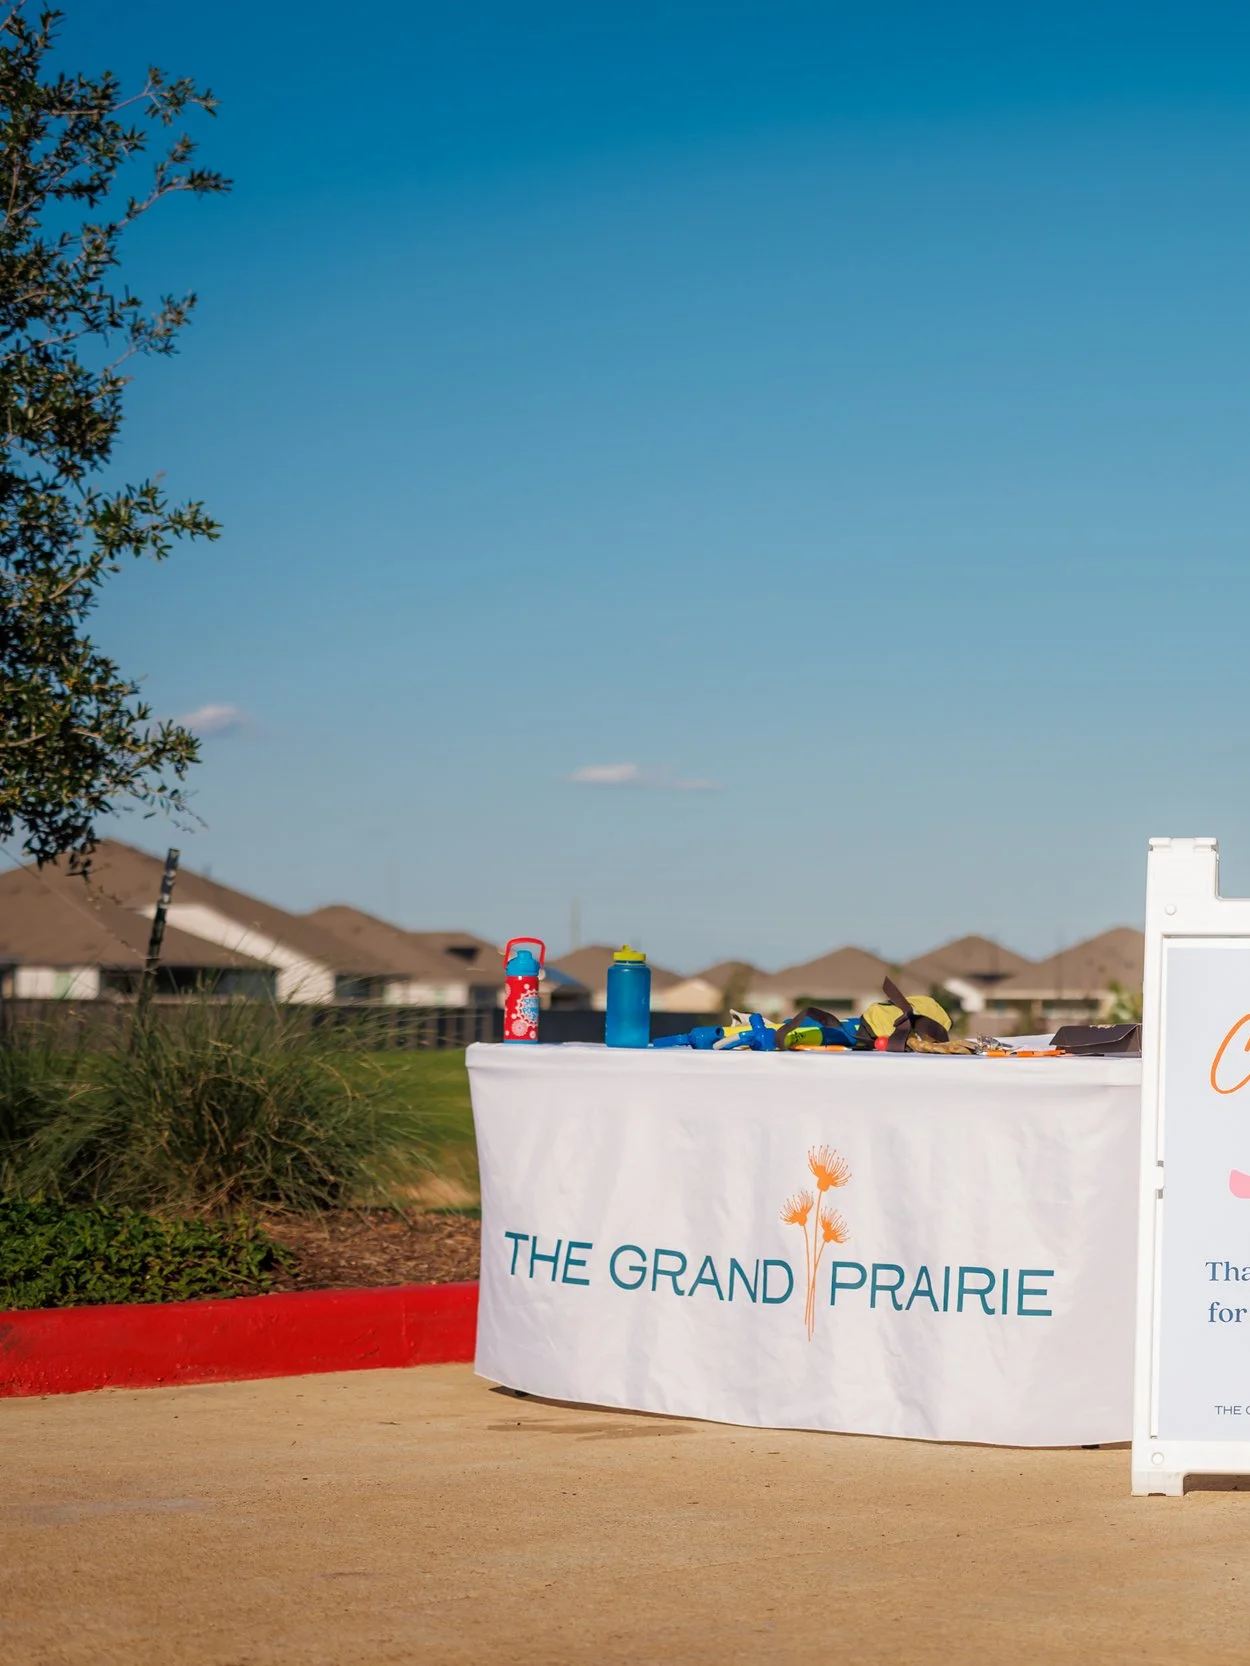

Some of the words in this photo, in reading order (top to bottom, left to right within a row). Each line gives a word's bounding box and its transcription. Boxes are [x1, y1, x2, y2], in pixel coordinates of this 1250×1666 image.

[504, 1231, 594, 1287] THE
[609, 1244, 794, 1305] GRAND
[829, 1261, 1055, 1317] PRAIRIE
[1207, 1301, 1248, 1323] for
[1214, 1405, 1242, 1416] THE
